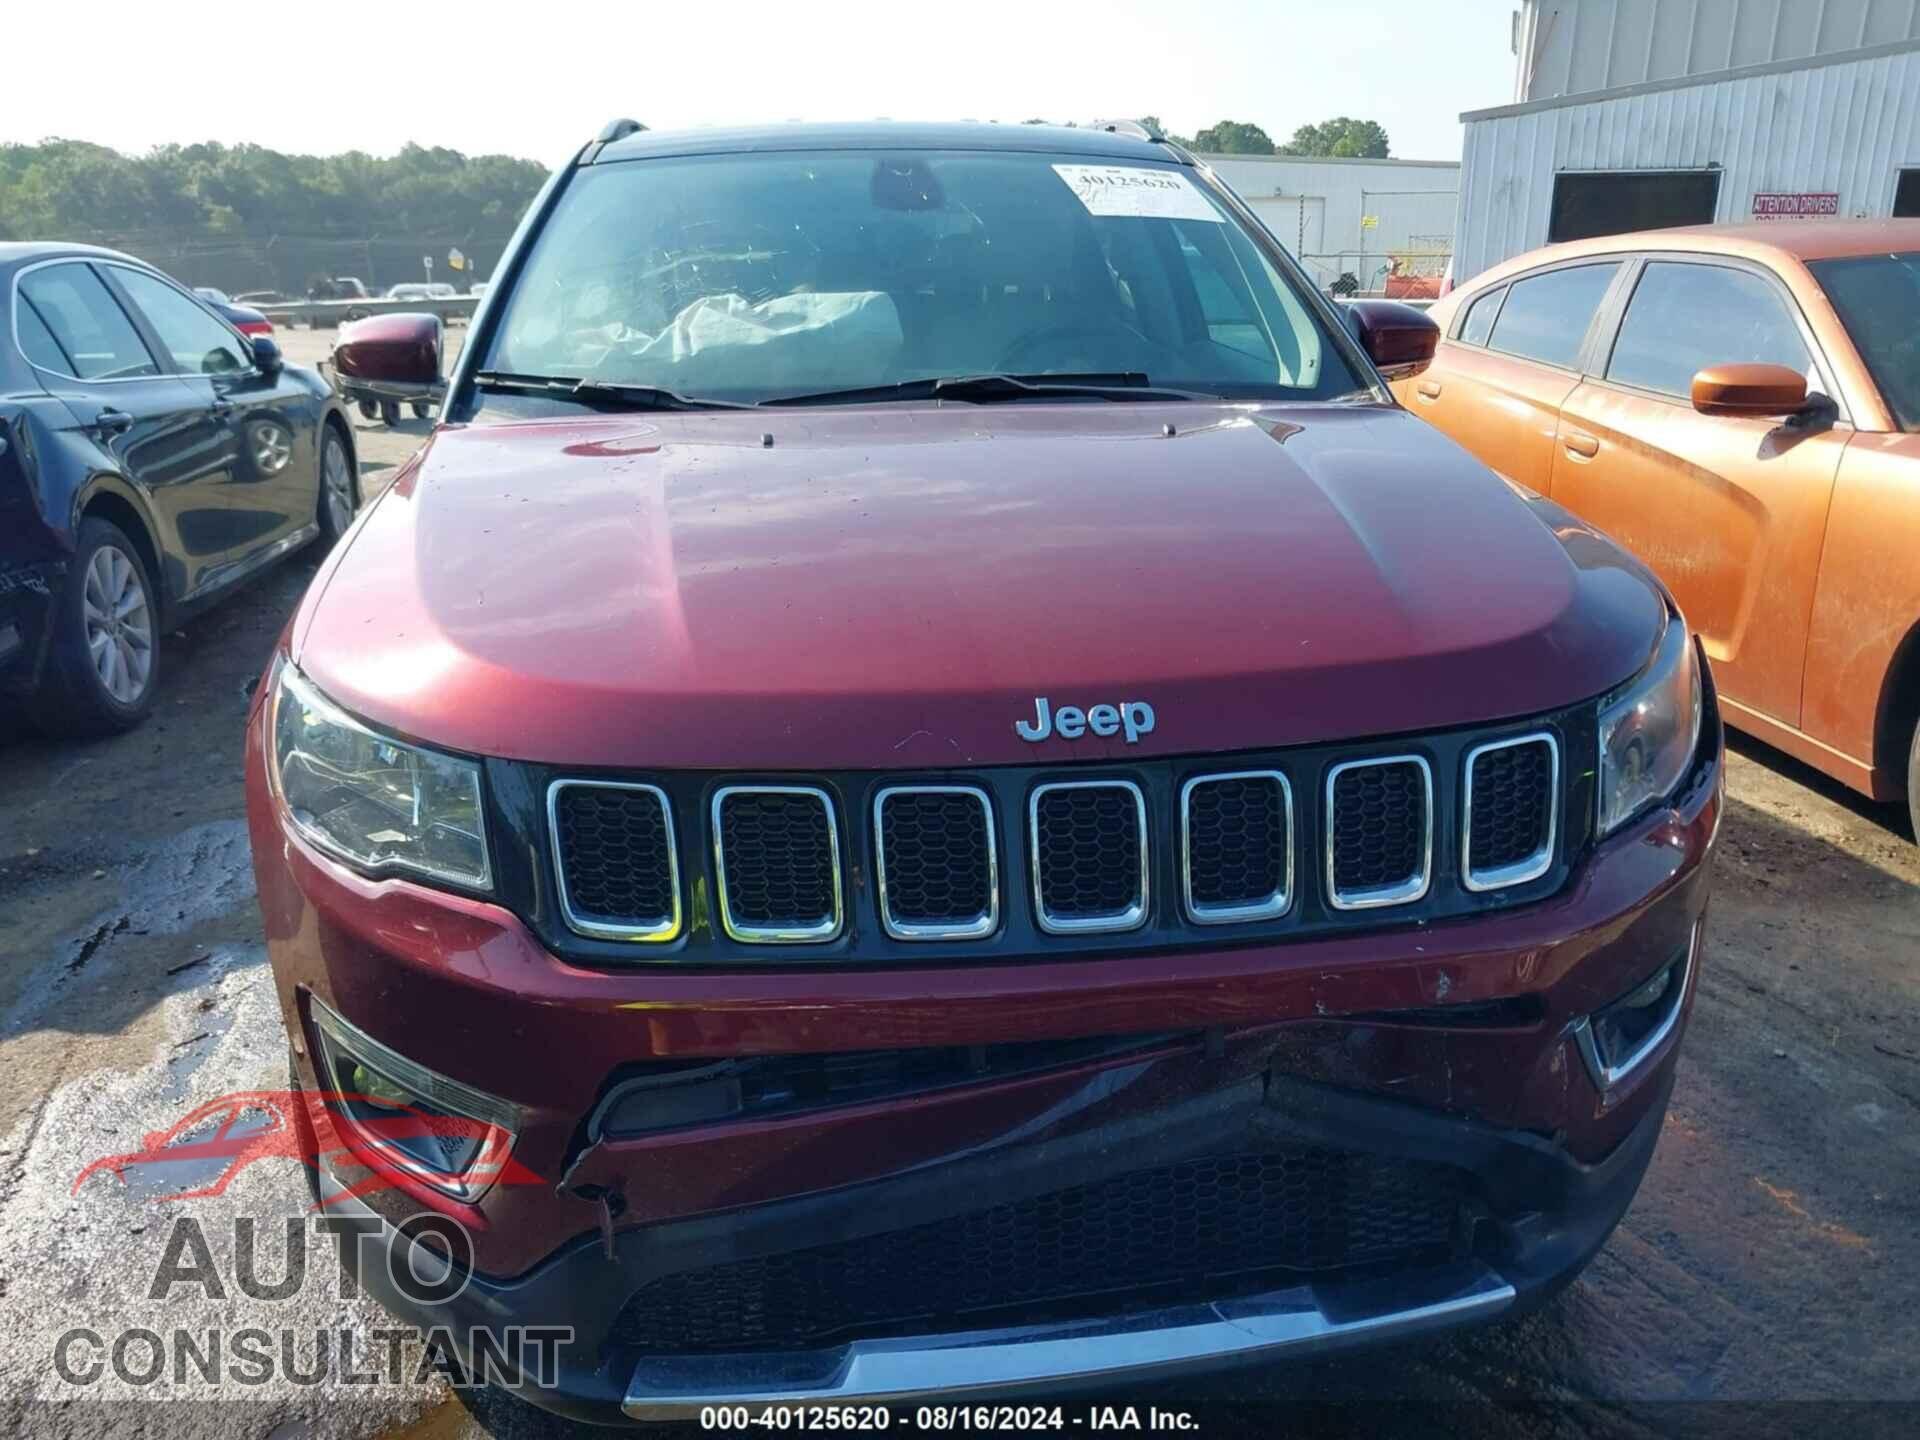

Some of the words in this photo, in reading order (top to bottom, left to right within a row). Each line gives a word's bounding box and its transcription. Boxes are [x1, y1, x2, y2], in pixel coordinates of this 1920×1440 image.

[1753, 196, 1798, 213] ATTENTION
[1800, 195, 1837, 213] DRIVERS
[1015, 697, 1155, 743] Jeep
